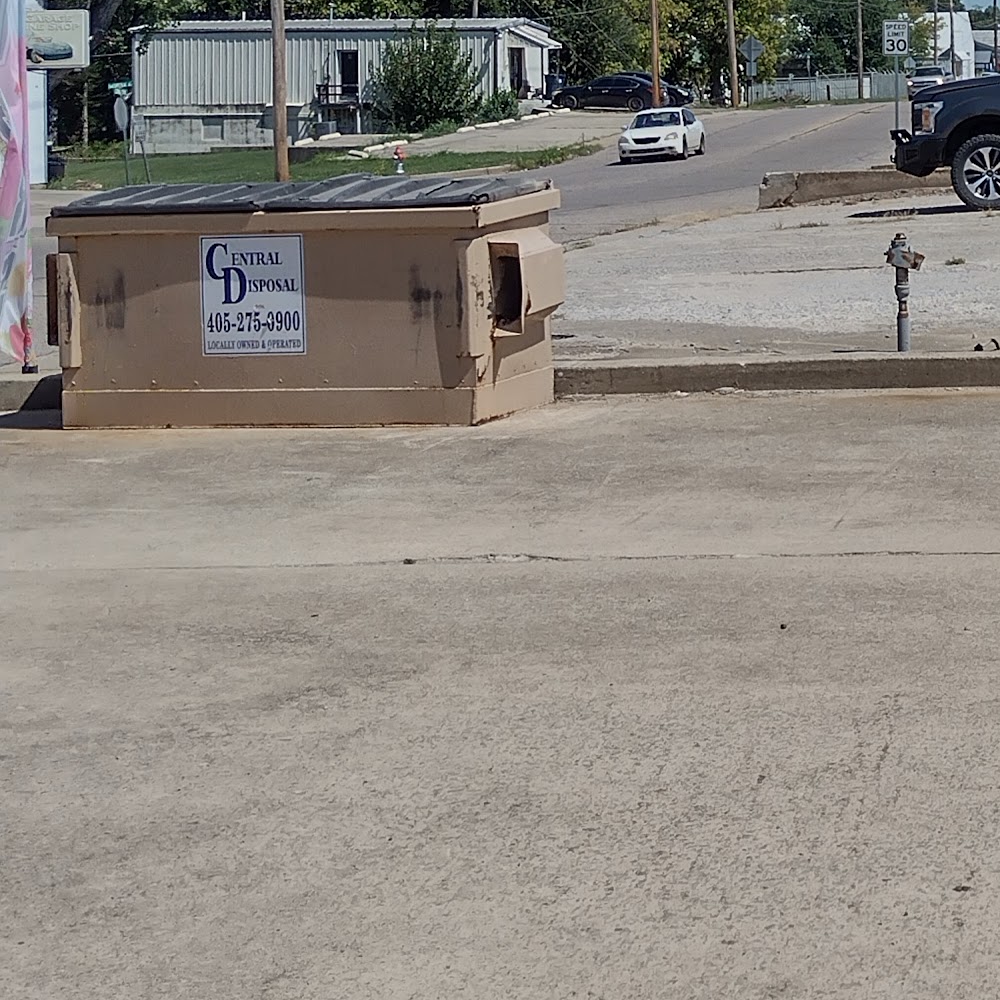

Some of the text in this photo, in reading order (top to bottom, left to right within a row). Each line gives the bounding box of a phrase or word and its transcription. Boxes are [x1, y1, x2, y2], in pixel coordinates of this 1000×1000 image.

[885, 39, 907, 52] 30
[206, 243, 283, 280] CENTRAL
[221, 266, 299, 305] DISPOSAL
[207, 340, 236, 350] LOCALLY
[237, 340, 260, 349] OWNED
